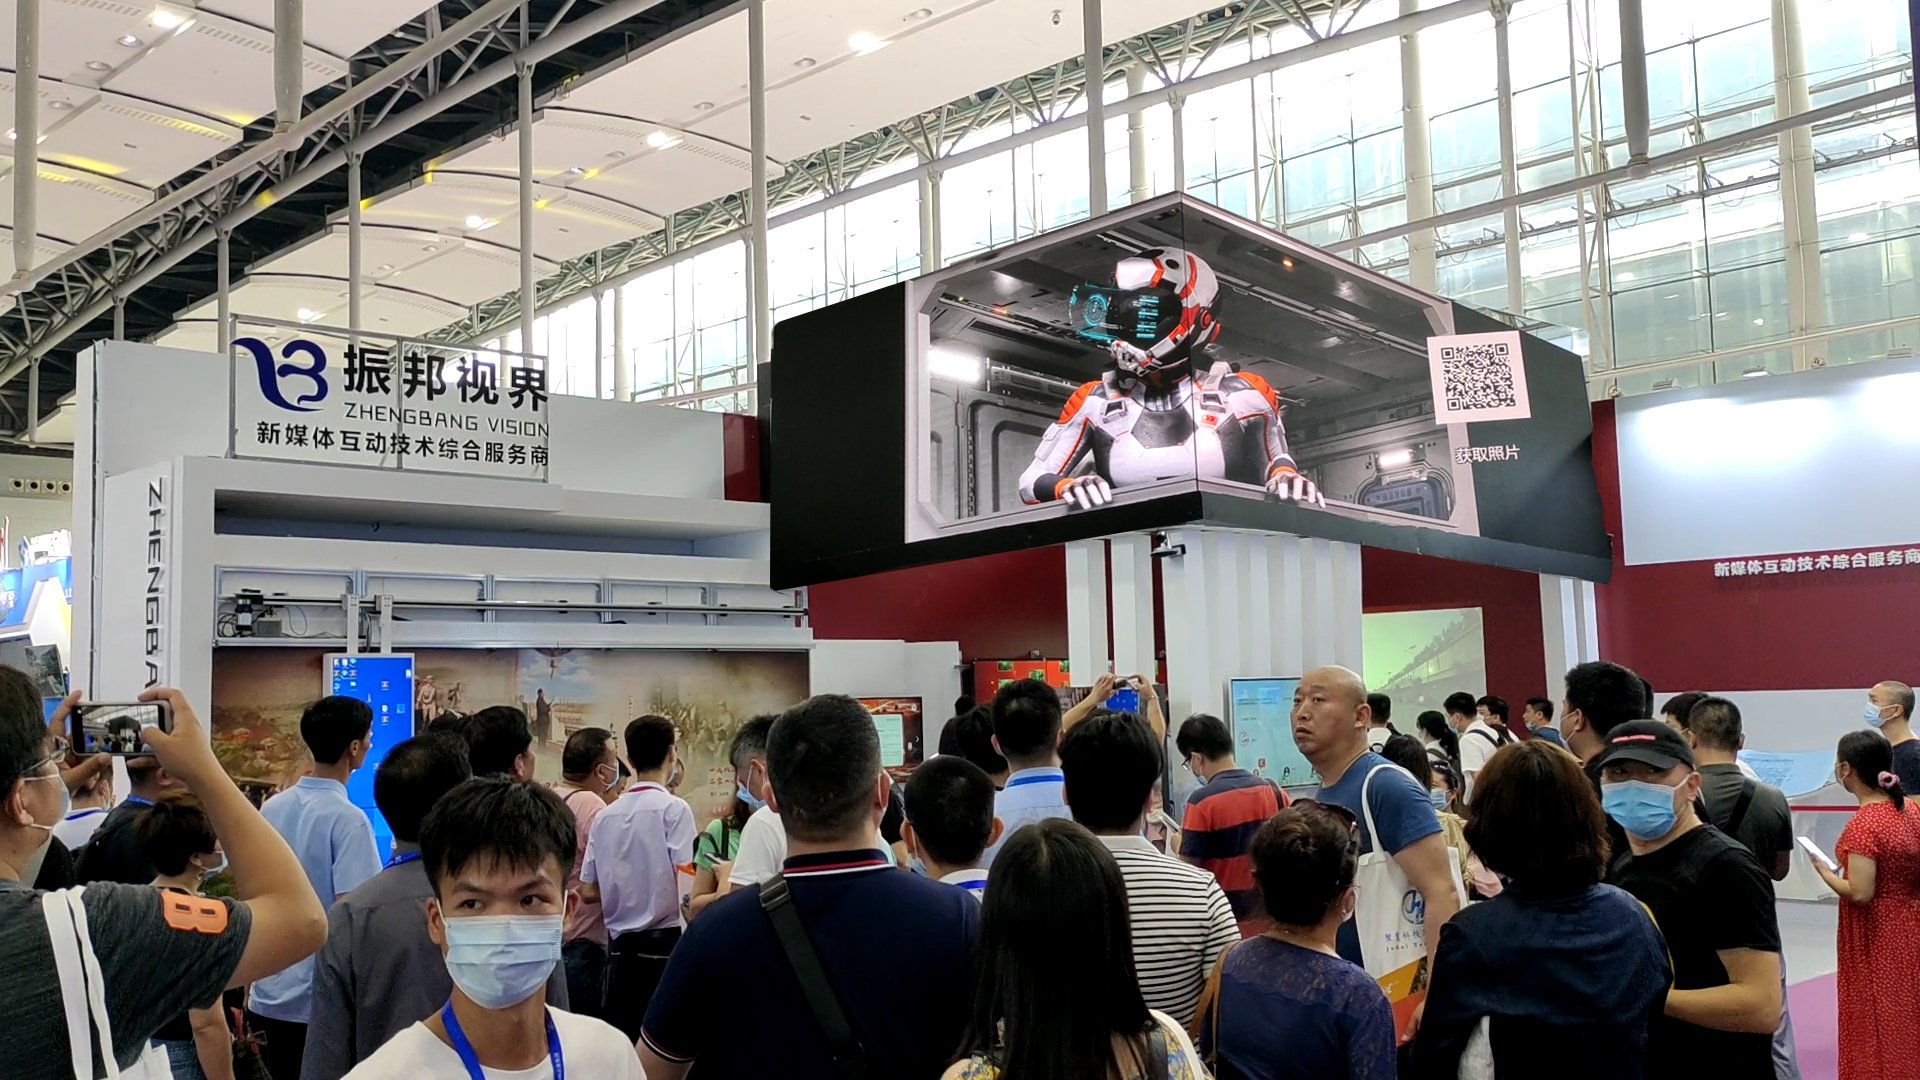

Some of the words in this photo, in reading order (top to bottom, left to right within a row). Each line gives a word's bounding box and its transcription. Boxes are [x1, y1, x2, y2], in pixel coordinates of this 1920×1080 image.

[343, 343, 549, 411] 振邦视界
[343, 402, 478, 431] ZHENGBANG
[487, 417, 550, 438] VISION
[256, 420, 549, 466] 新媒体互动技术综合服务商
[1454, 444, 1520, 464] 获取照片
[1714, 548, 1920, 578] 新媒体互动技术综合服务商
